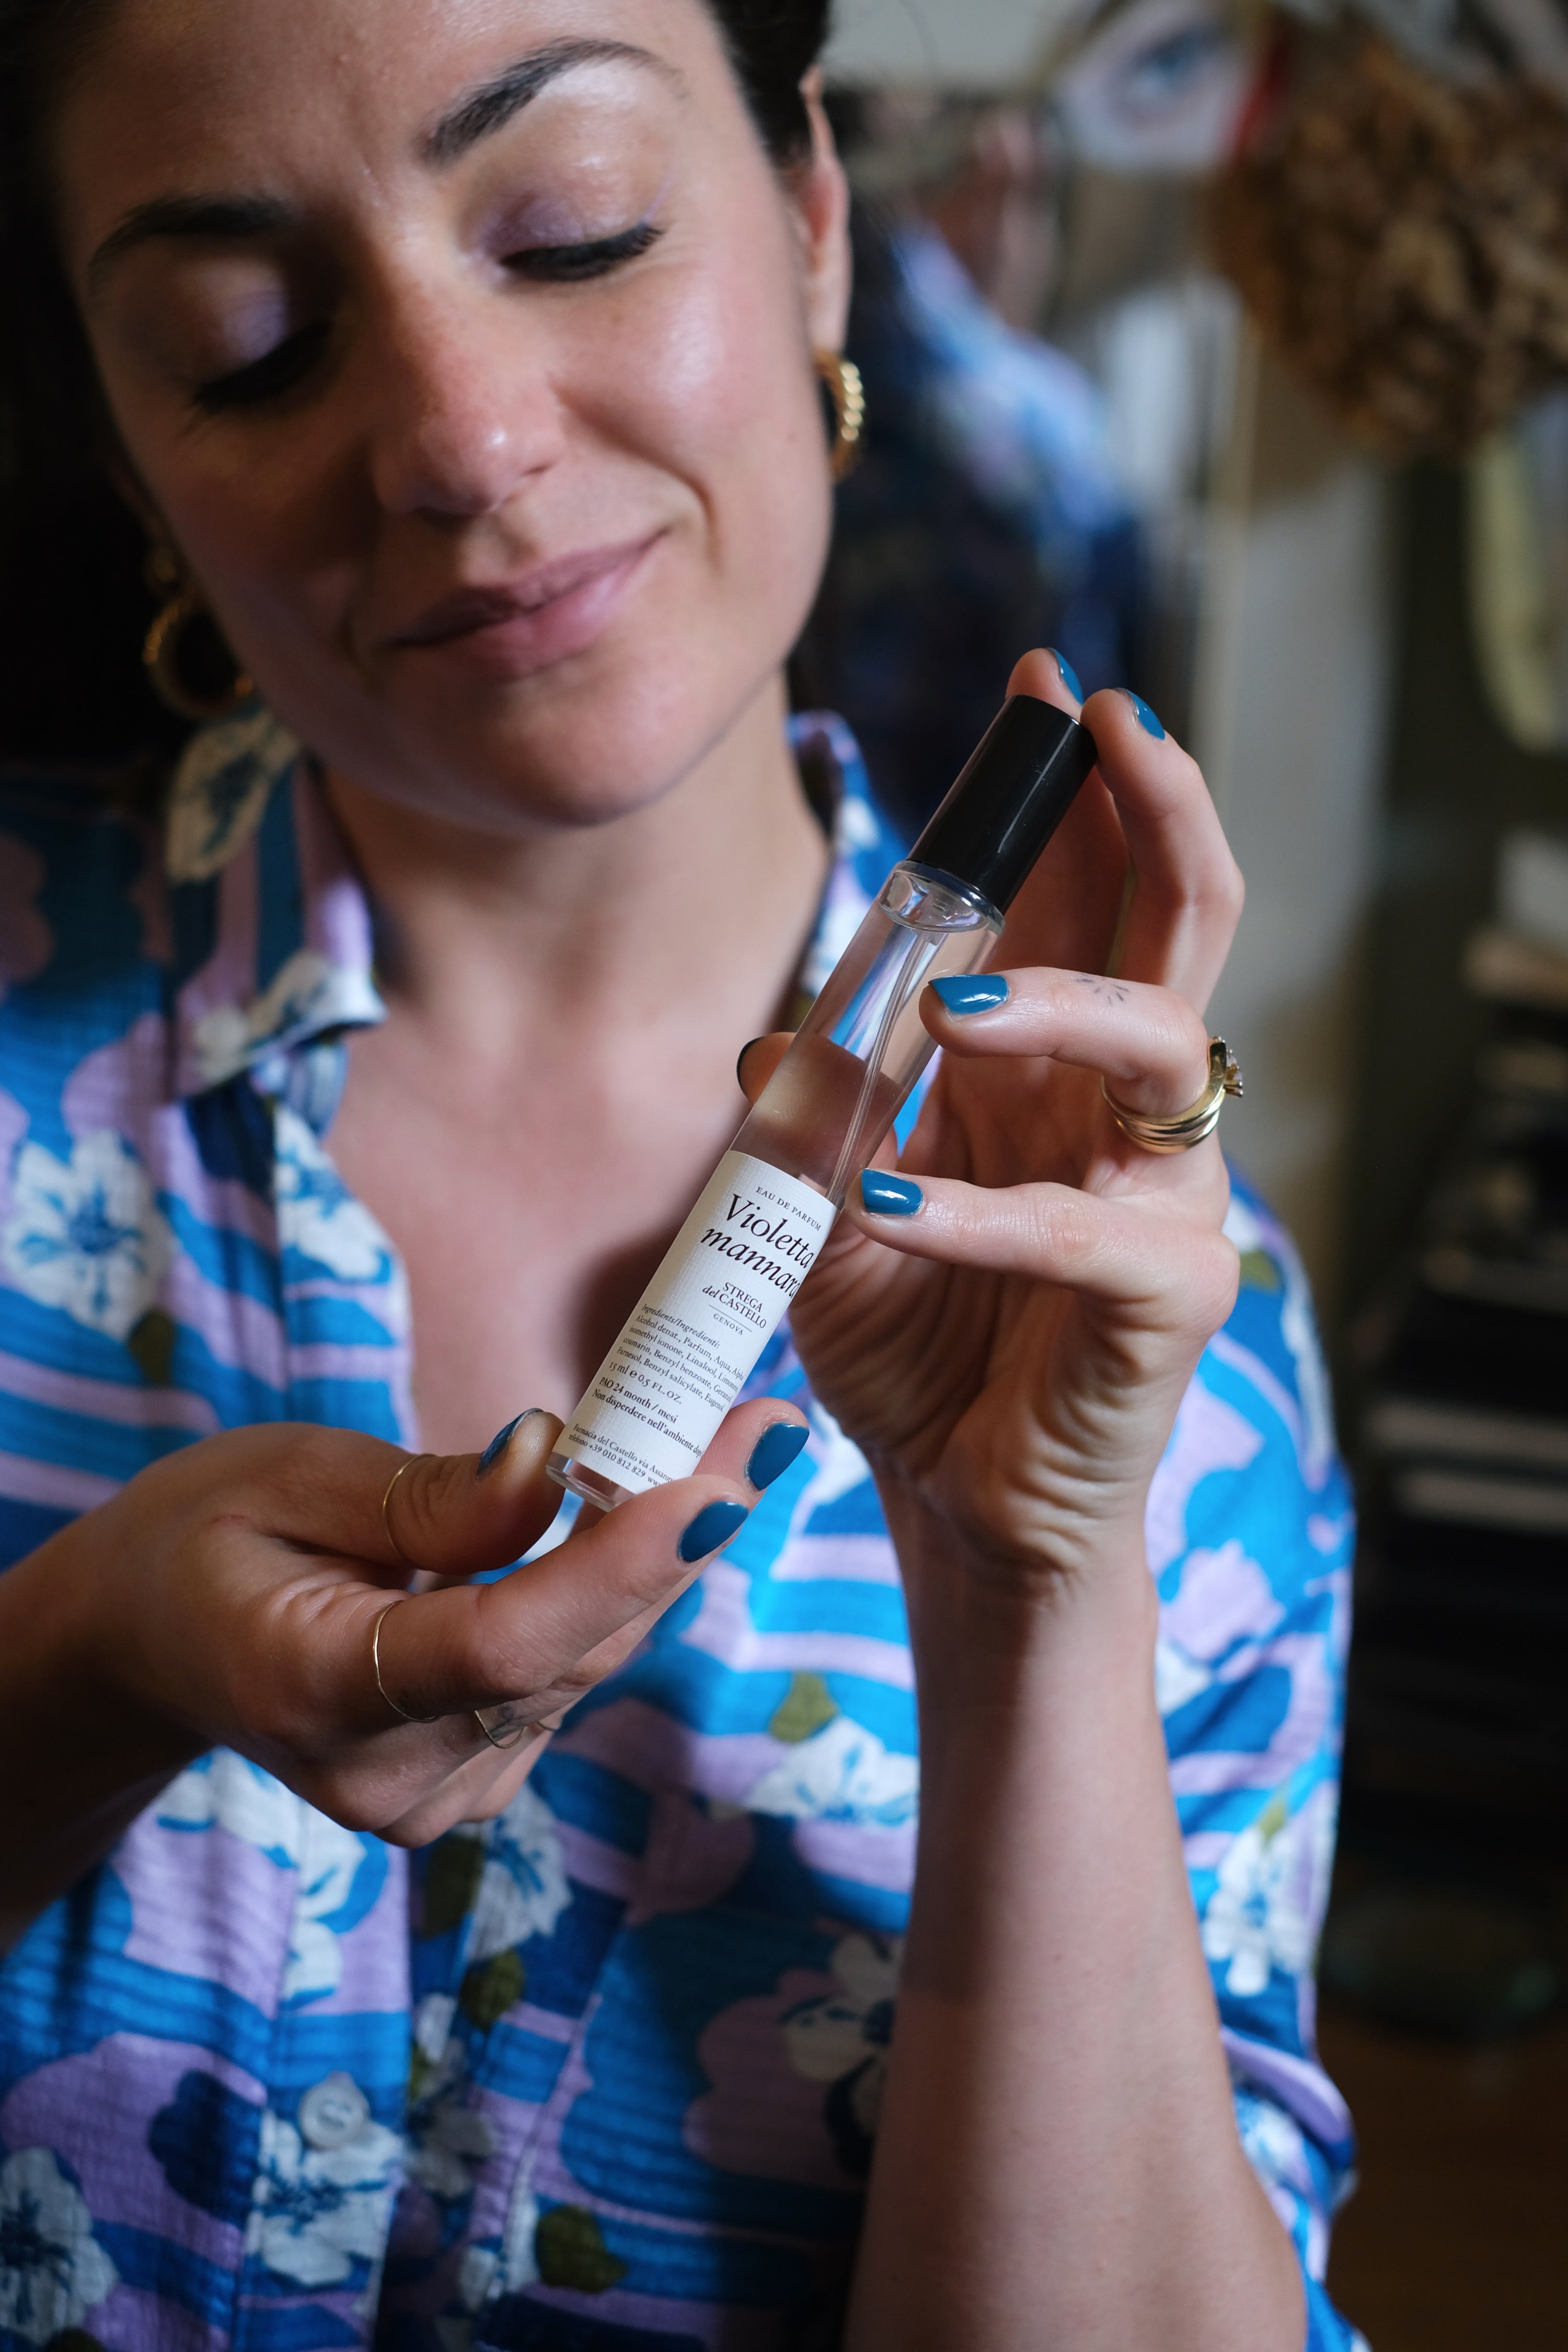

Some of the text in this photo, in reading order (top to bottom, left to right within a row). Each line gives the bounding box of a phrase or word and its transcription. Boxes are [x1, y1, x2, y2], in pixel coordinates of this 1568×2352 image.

[727, 1193, 814, 1269] Violetta
[756, 1186, 821, 1231] EAU DE PARFUM
[702, 1286, 767, 1329] del CASTELLO
[723, 1282, 763, 1312] STREGA
[635, 1315, 659, 1329] Alcohol
[658, 1324, 681, 1343] denat.,
[683, 1337, 712, 1361] Parfum,
[714, 1356, 731, 1373] Aqua,
[641, 1304, 720, 1349] Ingredients/Ingredienti:
[713, 1313, 743, 1335] GENOVA
[617, 1346, 642, 1364] Farnesol,
[643, 1358, 670, 1376] Benzyl
[669, 1374, 704, 1399] salicylate,
[623, 1338, 651, 1355] coumarin,
[653, 1349, 681, 1368] Benzyl
[680, 1363, 712, 1389] benzoate,
[629, 1325, 658, 1342] isomethyl
[657, 1337, 684, 1358] ionone,
[686, 1352, 717, 1378] Linalool,
[609, 1362, 618, 1371] 15
[617, 1365, 630, 1374] ml
[638, 1375, 651, 1387] 0,5
[592, 1388, 605, 1401] Non
[606, 1395, 647, 1422] disperdere
[599, 1377, 614, 1388] PAO
[613, 1383, 624, 1393] 24
[624, 1390, 651, 1409] month
[658, 1408, 678, 1423] mesi
[568, 1434, 661, 1486] telefono +39 010 812 829 ww
[573, 1424, 597, 1440] Farmacia
[597, 1436, 609, 1446] del
[609, 1442, 637, 1461] Castello
[639, 1459, 649, 1469] via
